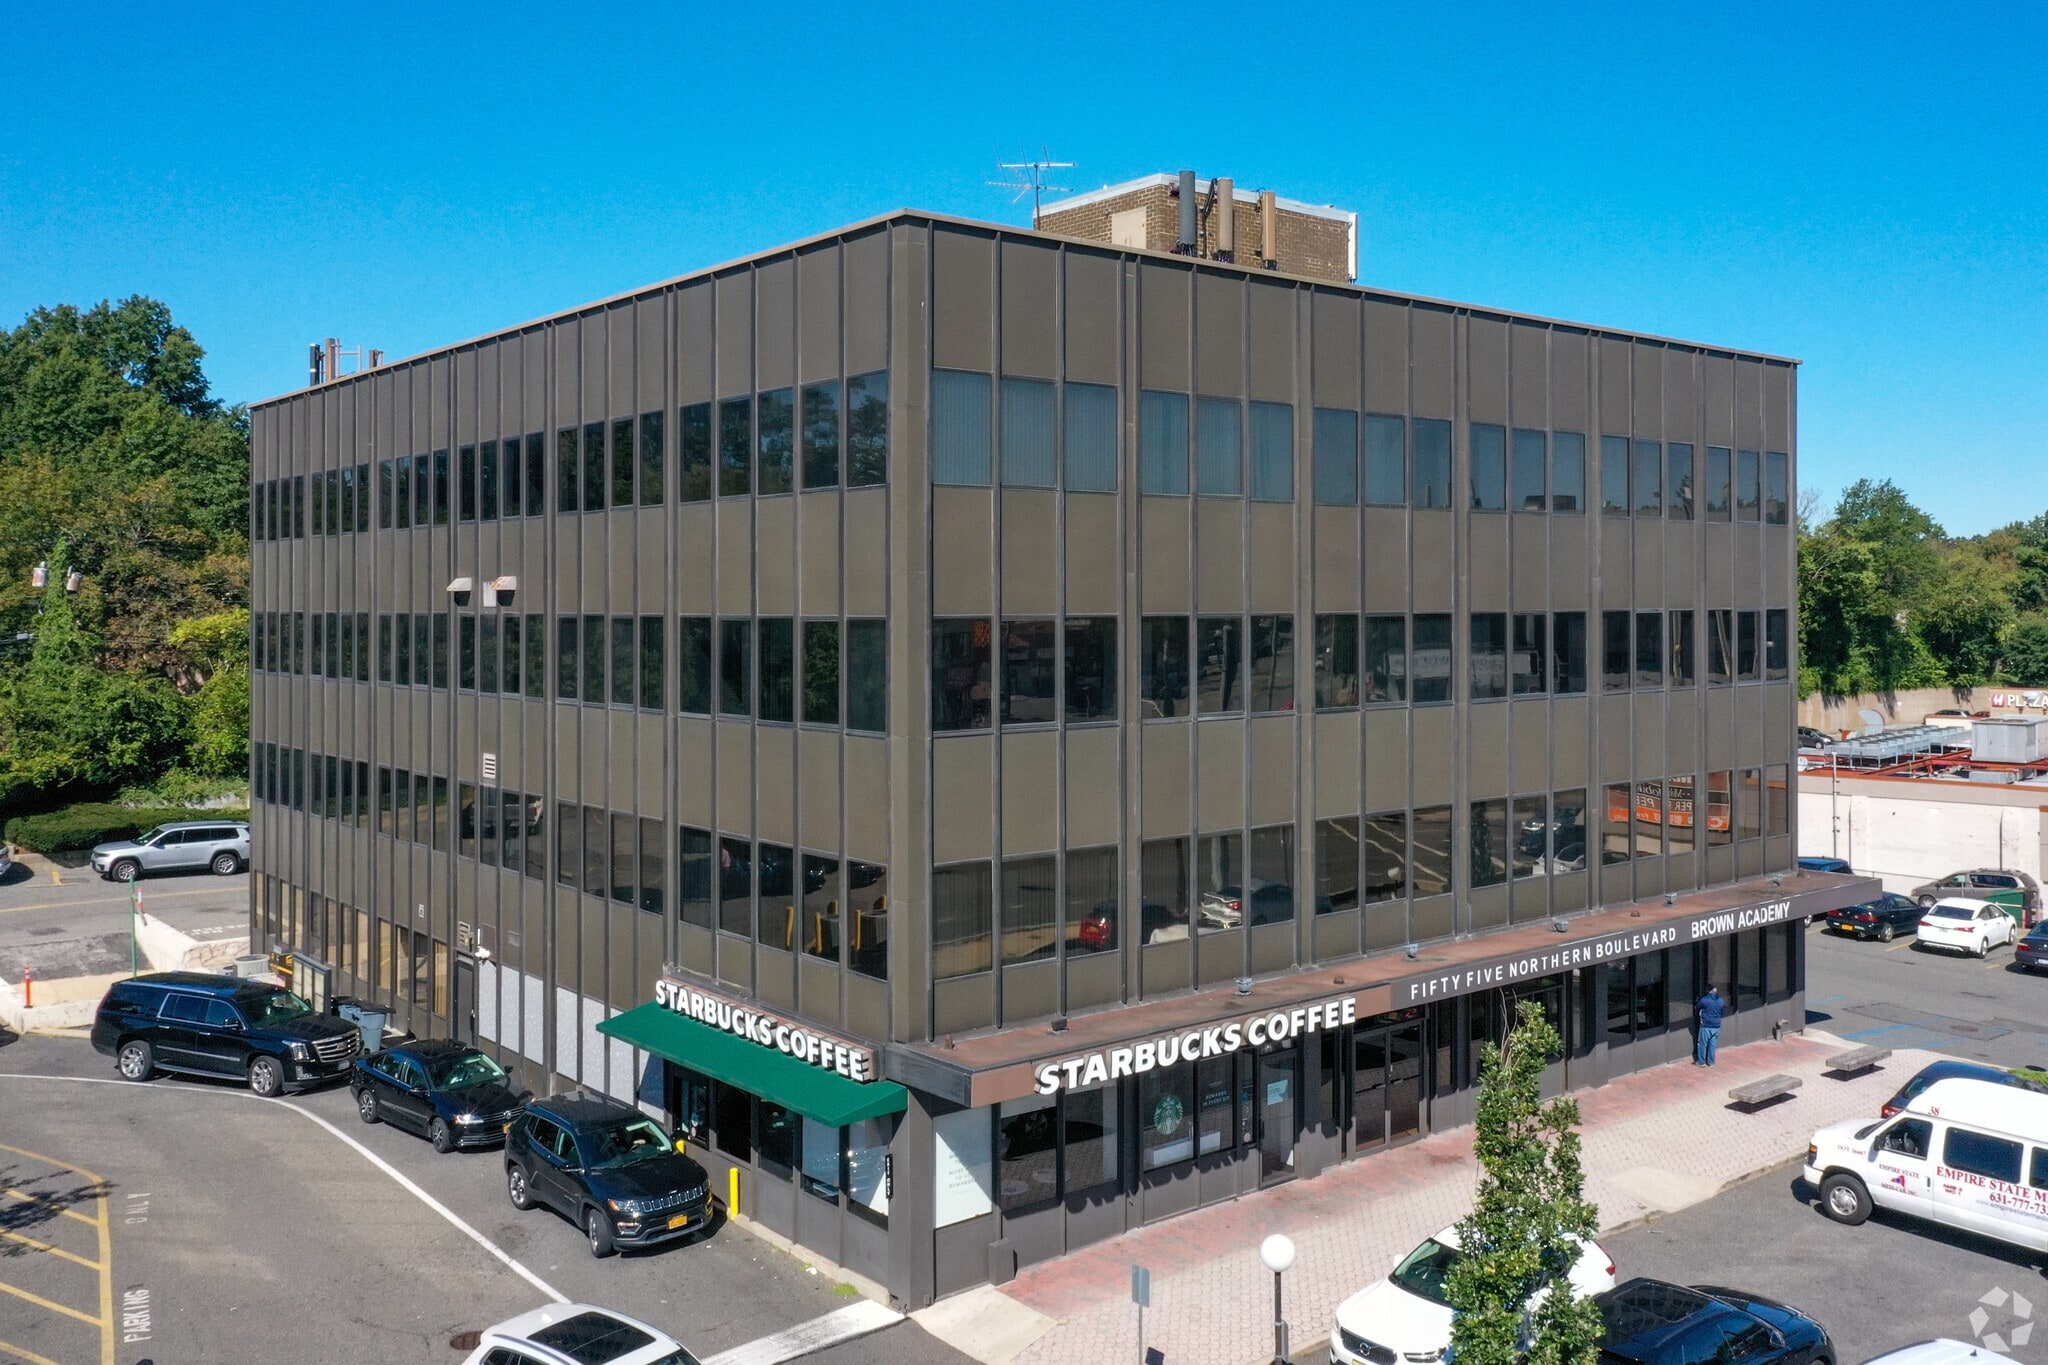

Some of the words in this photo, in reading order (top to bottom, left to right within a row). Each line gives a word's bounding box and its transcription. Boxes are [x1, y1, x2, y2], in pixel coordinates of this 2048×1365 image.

[2007, 694, 2048, 708] PLZA
[1692, 913, 1734, 938] BROWN
[1737, 901, 1790, 928] ACADEMY
[1411, 974, 1460, 1000] FIFTY
[1467, 966, 1503, 987] FIVE
[1509, 946, 1590, 978] NORTHERN
[1596, 927, 1676, 958] BOULEVARD
[655, 980, 773, 1046] STARBUCKS
[775, 1025, 866, 1082] COFFEE
[1037, 1022, 1241, 1095] STARBUCKS
[1246, 998, 1356, 1046] COFFEE
[1879, 1163, 1900, 1175] EMPIRE
[1902, 1169, 1920, 1179] STATE
[1936, 1166, 1986, 1188] EMPIRE
[1989, 1179, 2031, 1199] STATE
[125, 1193, 151, 1225] ONLY
[1989, 1192, 2048, 1218] 631-777-73
[123, 1289, 152, 1343] PARKING
